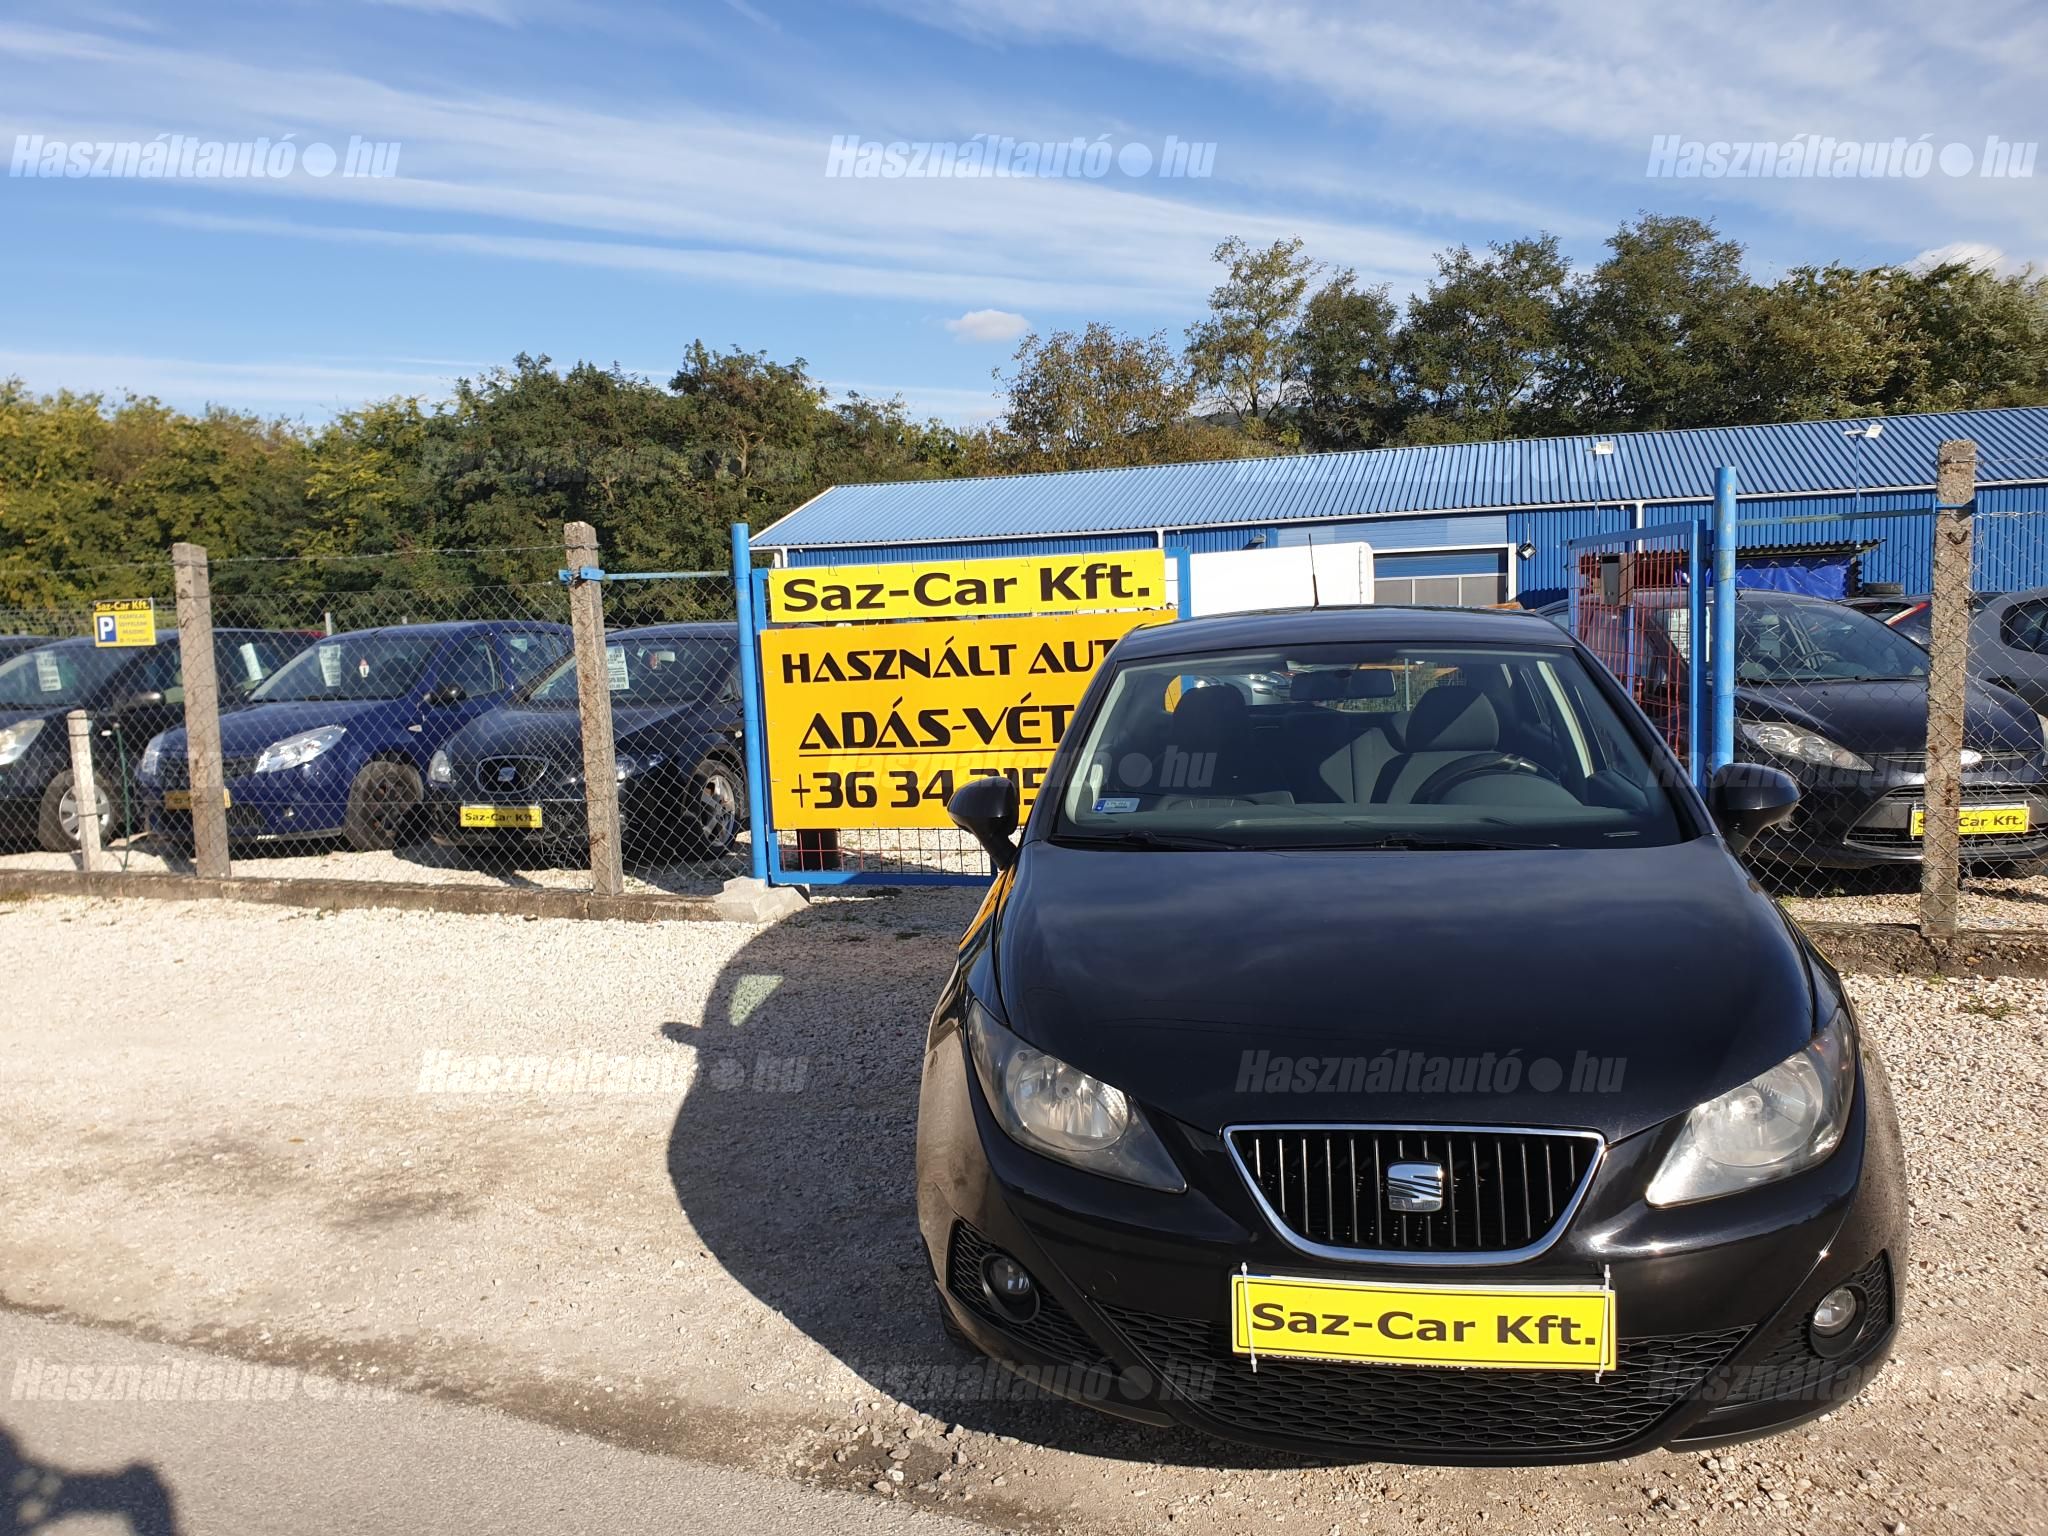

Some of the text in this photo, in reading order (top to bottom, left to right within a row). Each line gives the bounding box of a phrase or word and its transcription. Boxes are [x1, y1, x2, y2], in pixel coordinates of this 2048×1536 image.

[783, 563, 1150, 612] Saz-Car Kft.
[99, 616, 114, 640] P
[782, 636, 1017, 684] HASZNÁLT
[799, 692, 1075, 750] ADÁS-VÉT
[791, 770, 878, 809] +36
[890, 769, 954, 808] 34
[1917, 815, 2023, 828] SCar Kft.
[1252, 1302, 1596, 1346] Saz-Car Kft.
